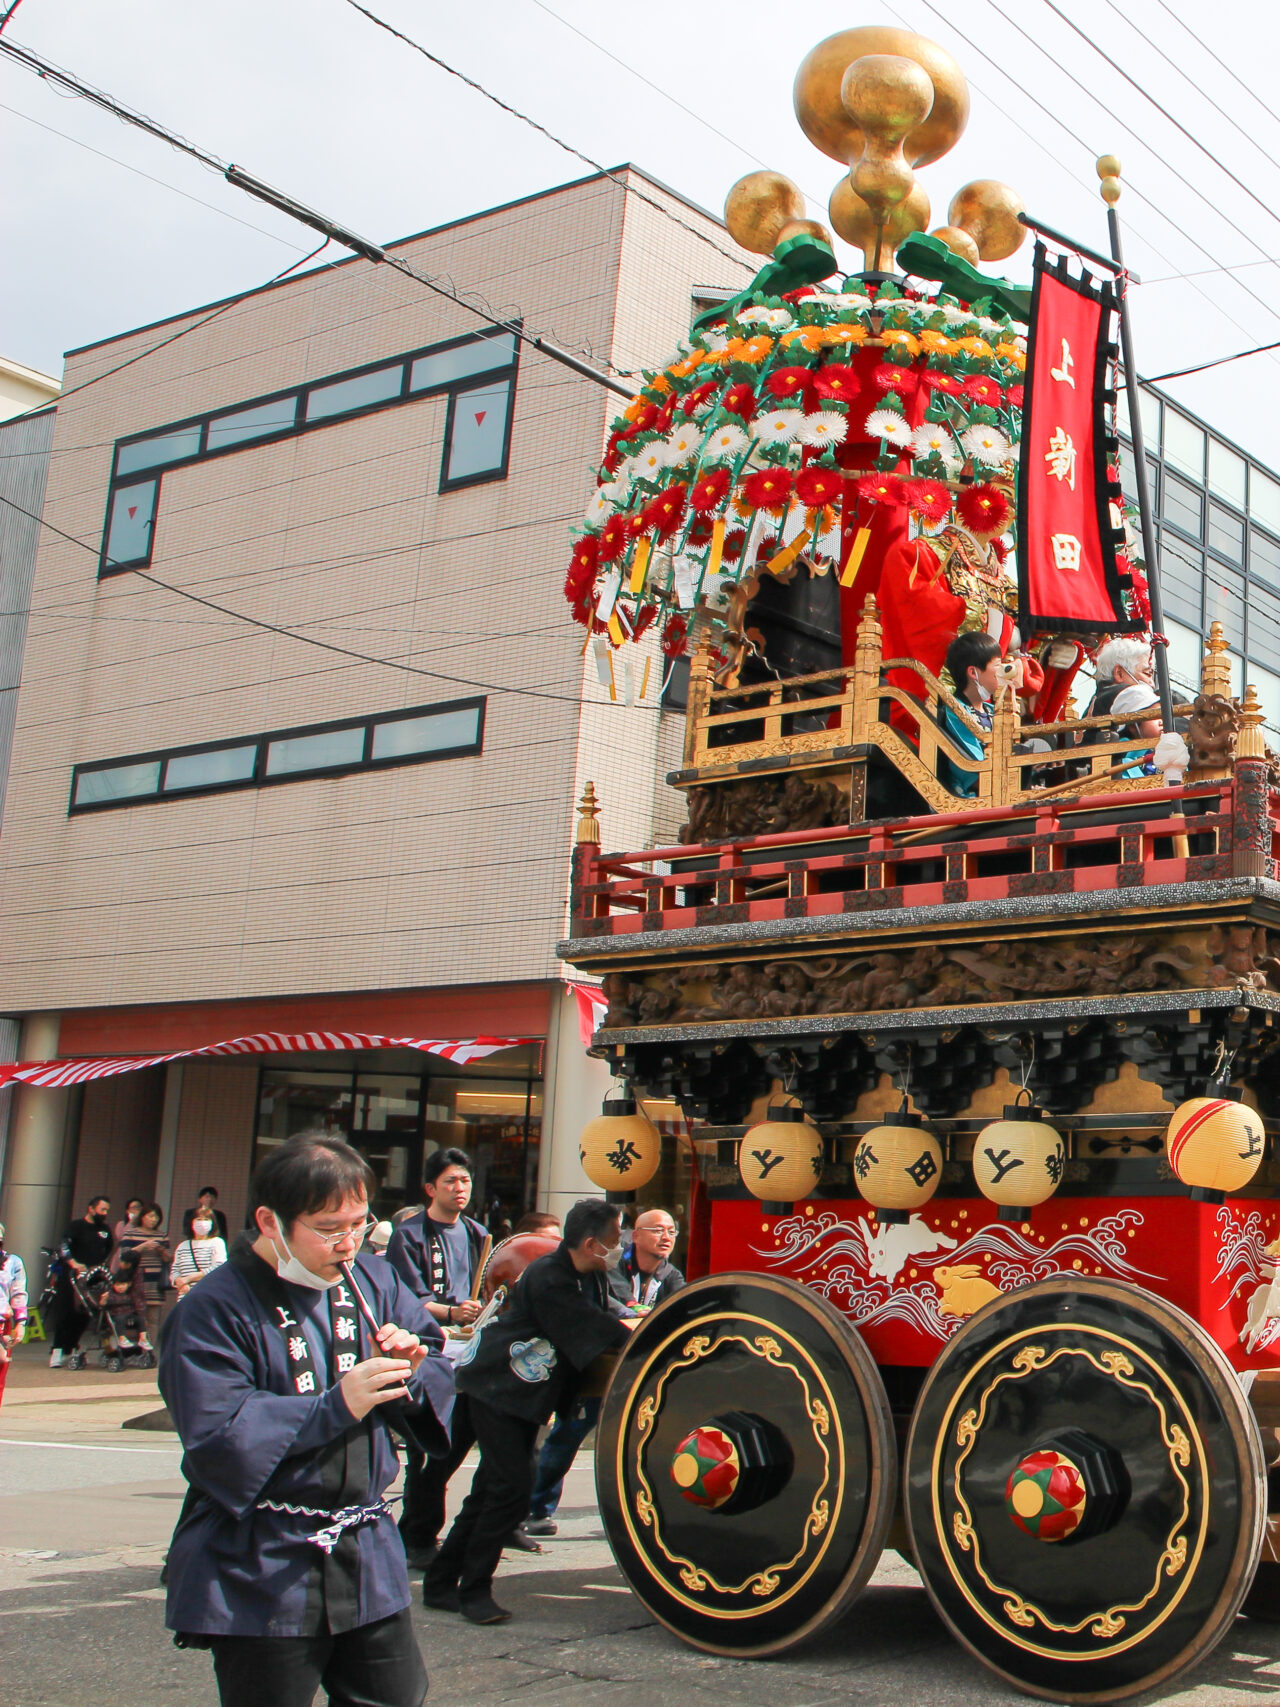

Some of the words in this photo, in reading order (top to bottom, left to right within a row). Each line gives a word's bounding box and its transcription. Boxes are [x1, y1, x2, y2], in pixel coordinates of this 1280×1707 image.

[1044, 337, 1083, 573] 上新田
[1239, 1124, 1262, 1160] 上
[431, 1236, 446, 1295] 上新田町
[275, 1306, 317, 1394] 上新田
[333, 1285, 358, 1373] 上新田
